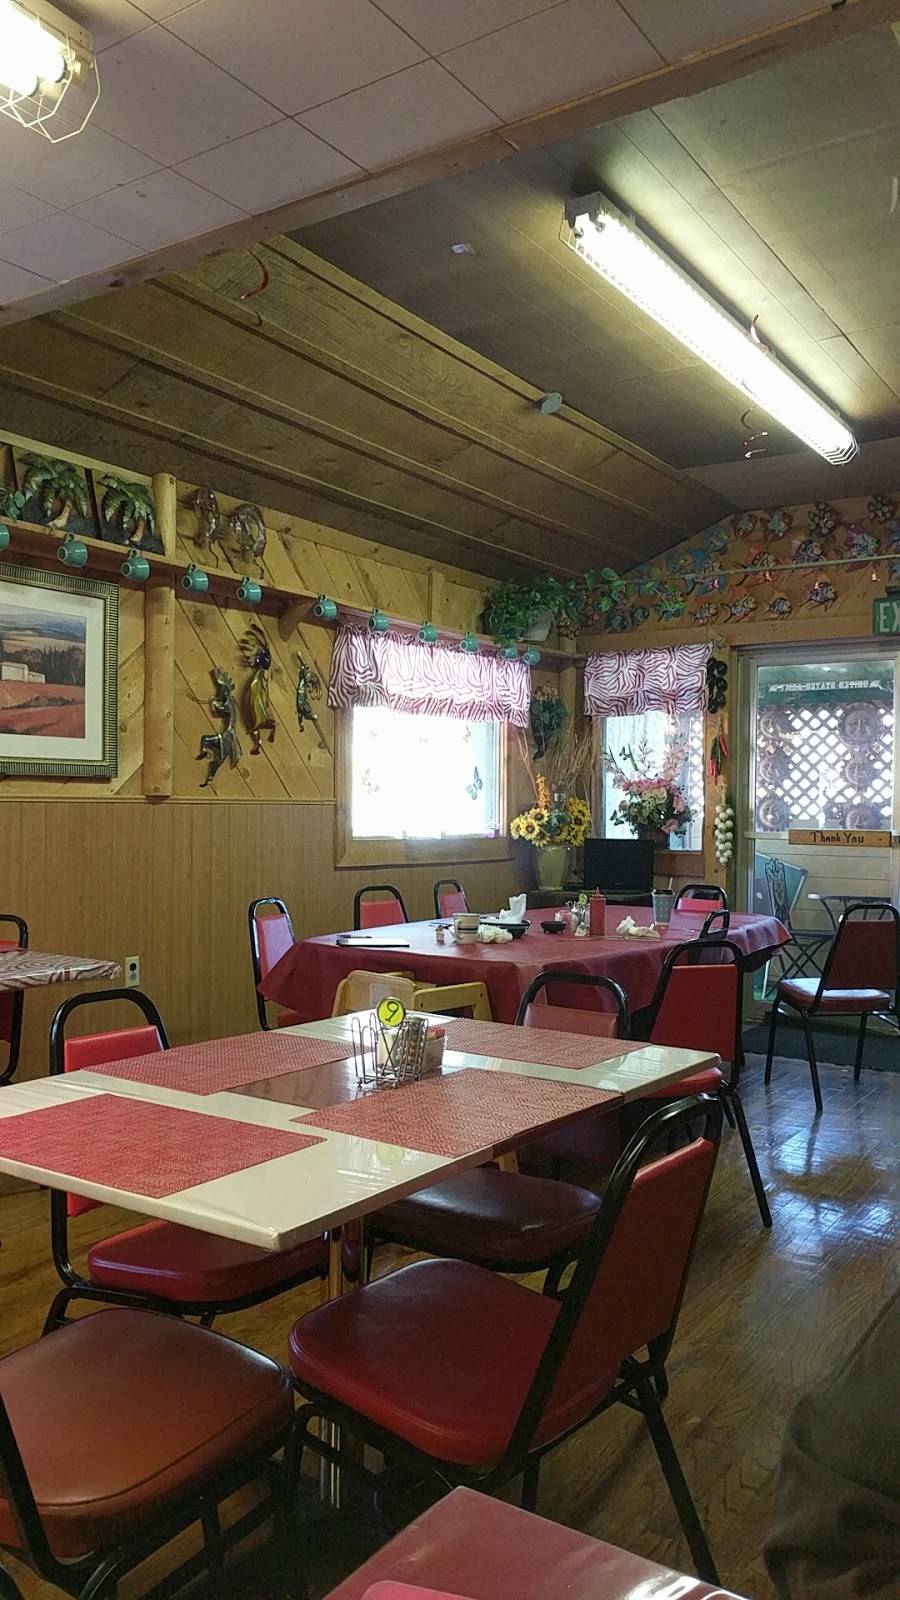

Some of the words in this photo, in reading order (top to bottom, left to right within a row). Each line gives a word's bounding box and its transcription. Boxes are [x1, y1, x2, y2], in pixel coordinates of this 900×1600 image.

[810, 831, 841, 843] Thank
[843, 832, 865, 844] You
[385, 1001, 400, 1022] 9
